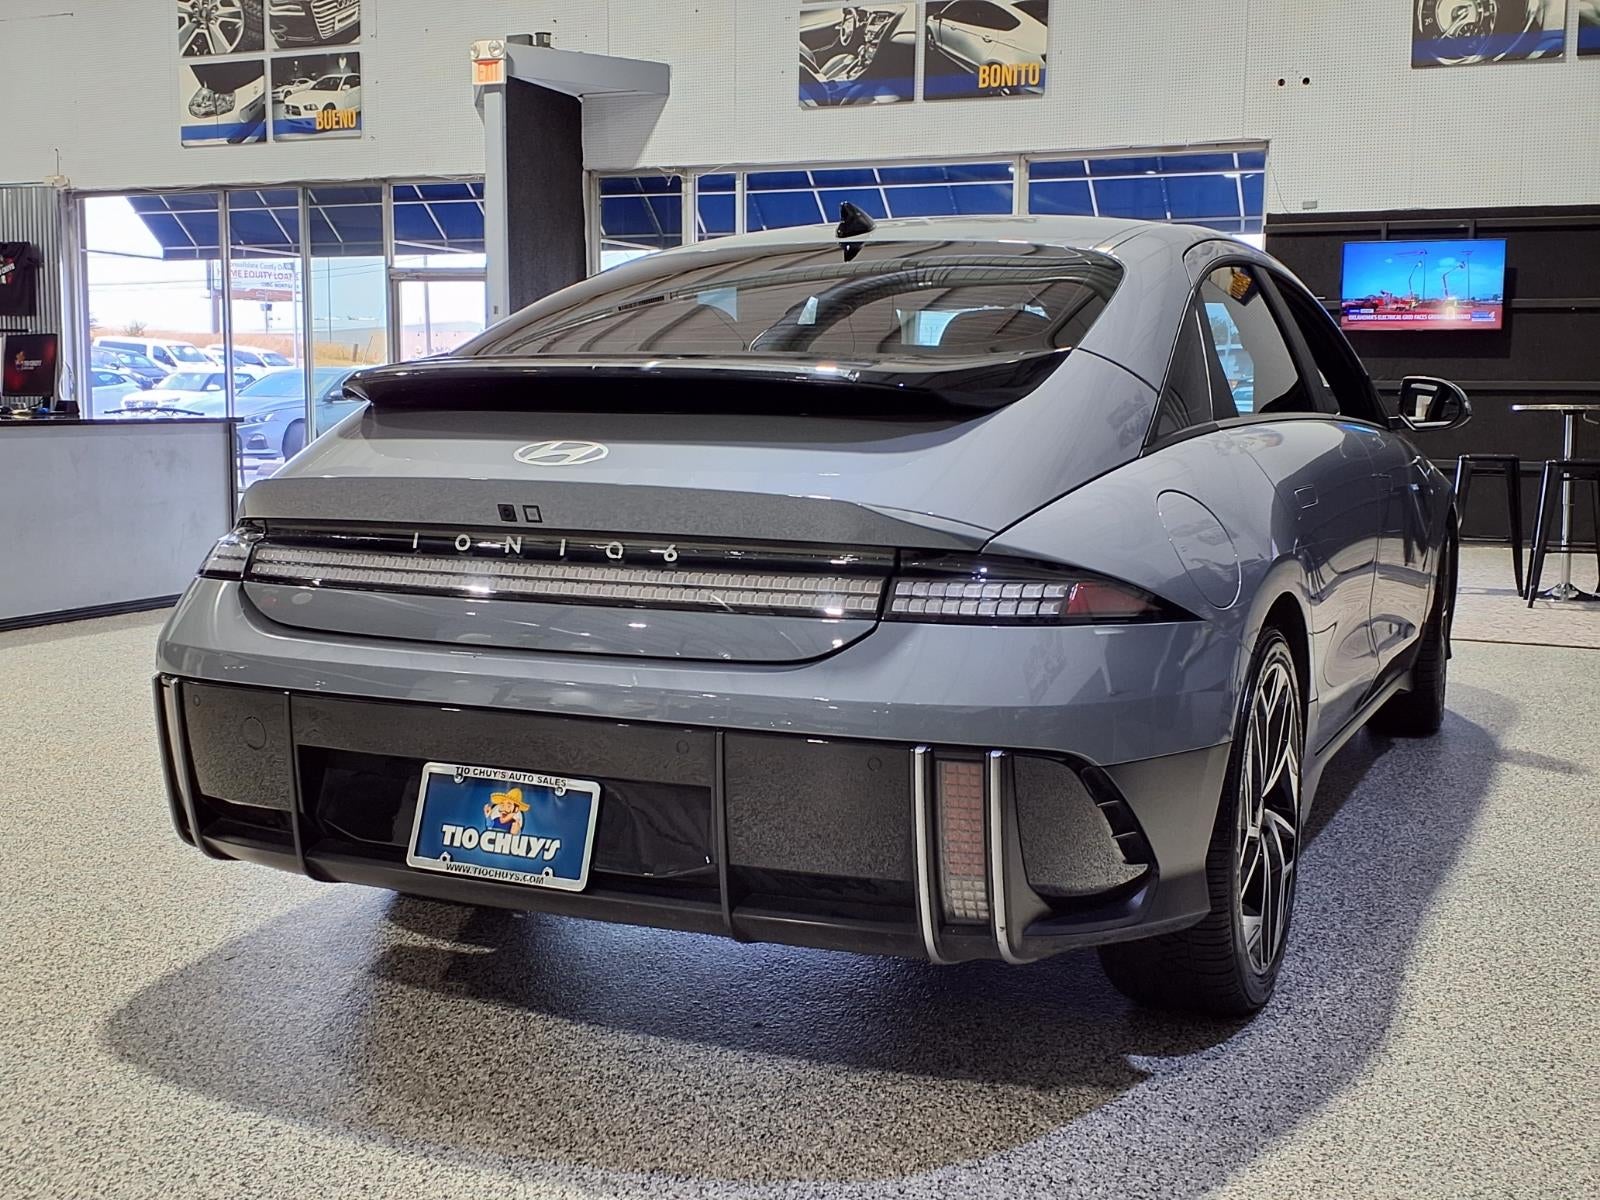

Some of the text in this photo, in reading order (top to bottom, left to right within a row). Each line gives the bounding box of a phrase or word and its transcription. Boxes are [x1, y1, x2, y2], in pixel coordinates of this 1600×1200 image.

[978, 63, 1040, 88] BONITO
[316, 109, 356, 130] BUENO
[244, 270, 272, 280] EQUITY
[412, 532, 678, 562] IONIQ 6
[456, 766, 567, 788] TIO CHUY'S AUTO SALES
[446, 863, 544, 885] WWW.TIOCHUYS.COM
